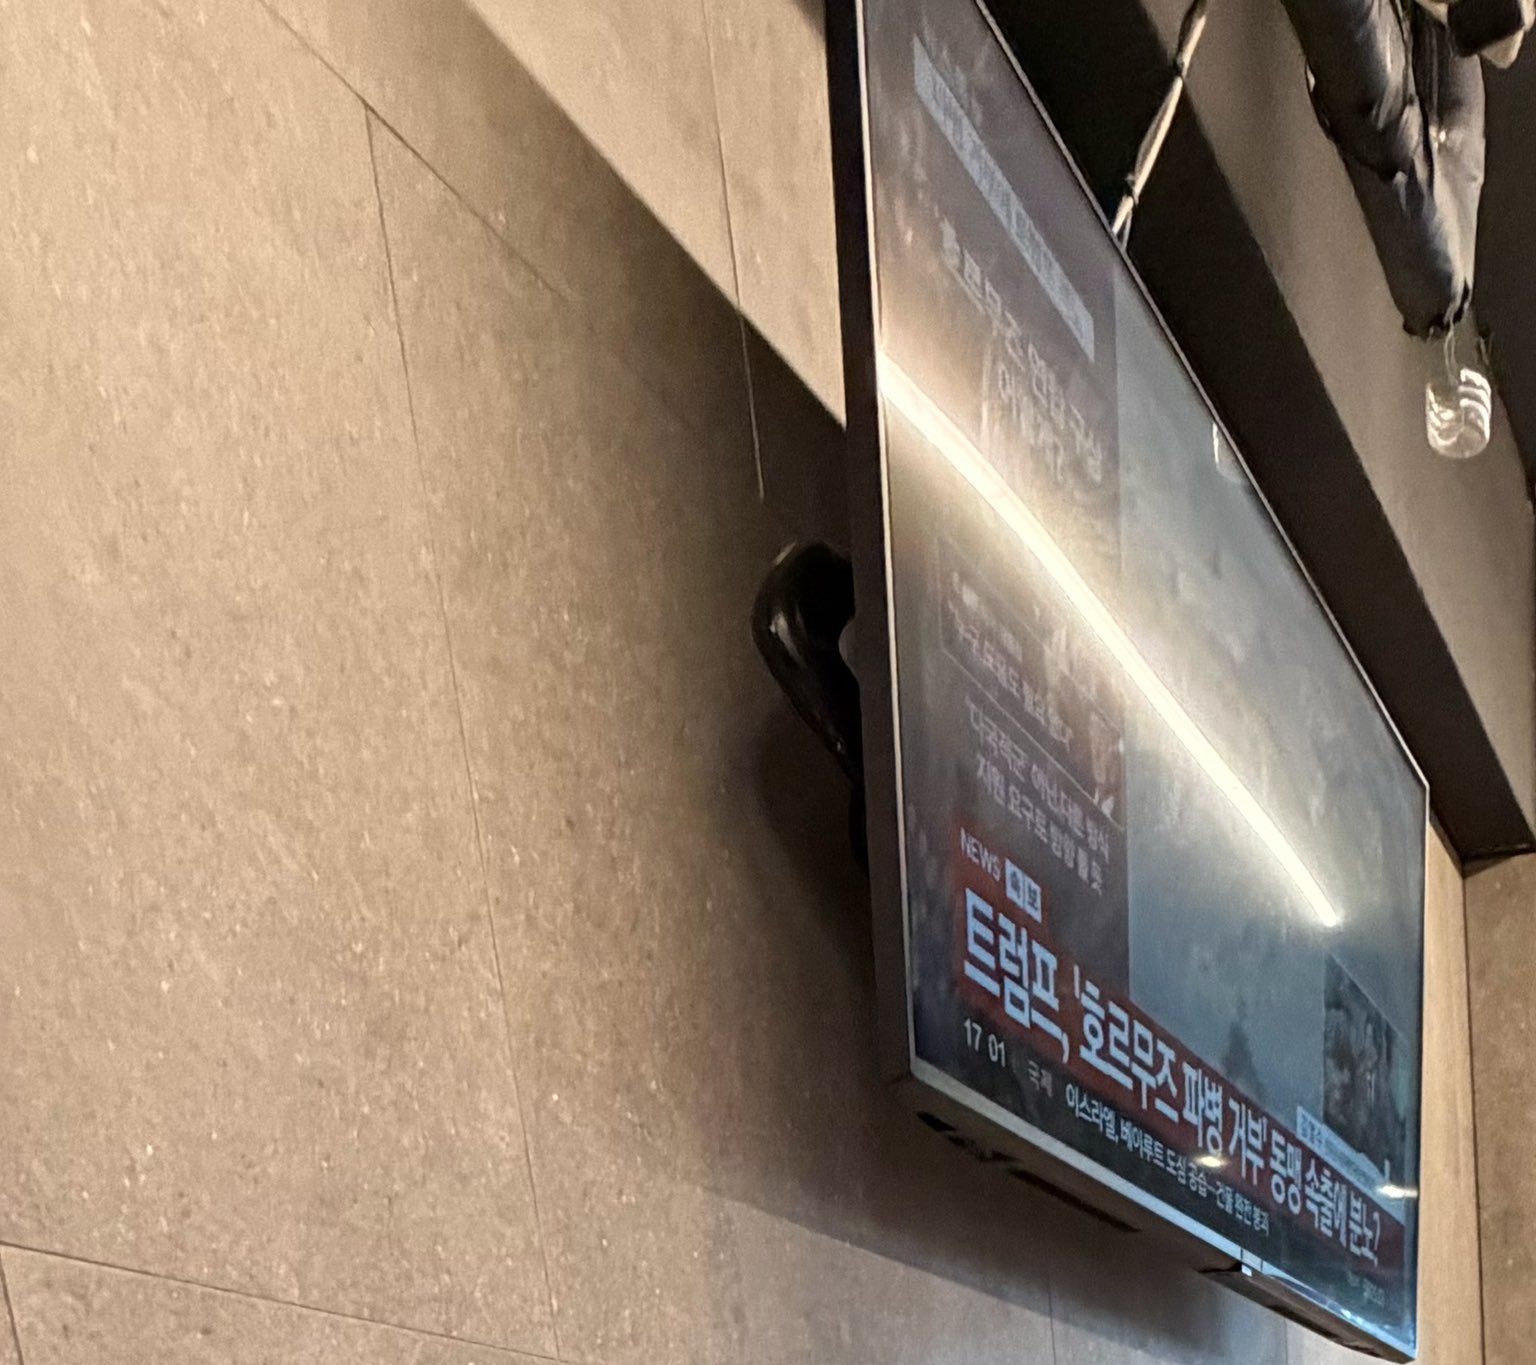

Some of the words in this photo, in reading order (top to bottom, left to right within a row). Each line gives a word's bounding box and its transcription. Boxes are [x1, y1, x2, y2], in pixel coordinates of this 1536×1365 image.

[960, 827, 1001, 882] NEWS
[964, 888, 1069, 1063] 트럼프,
[1074, 964, 1179, 1124] '호르무즈
[1183, 1061, 1223, 1153] 파병
[1270, 1130, 1301, 1215] 동맹
[1305, 1159, 1347, 1247] 속출에
[1120, 1121, 1165, 1169] 베이루트
